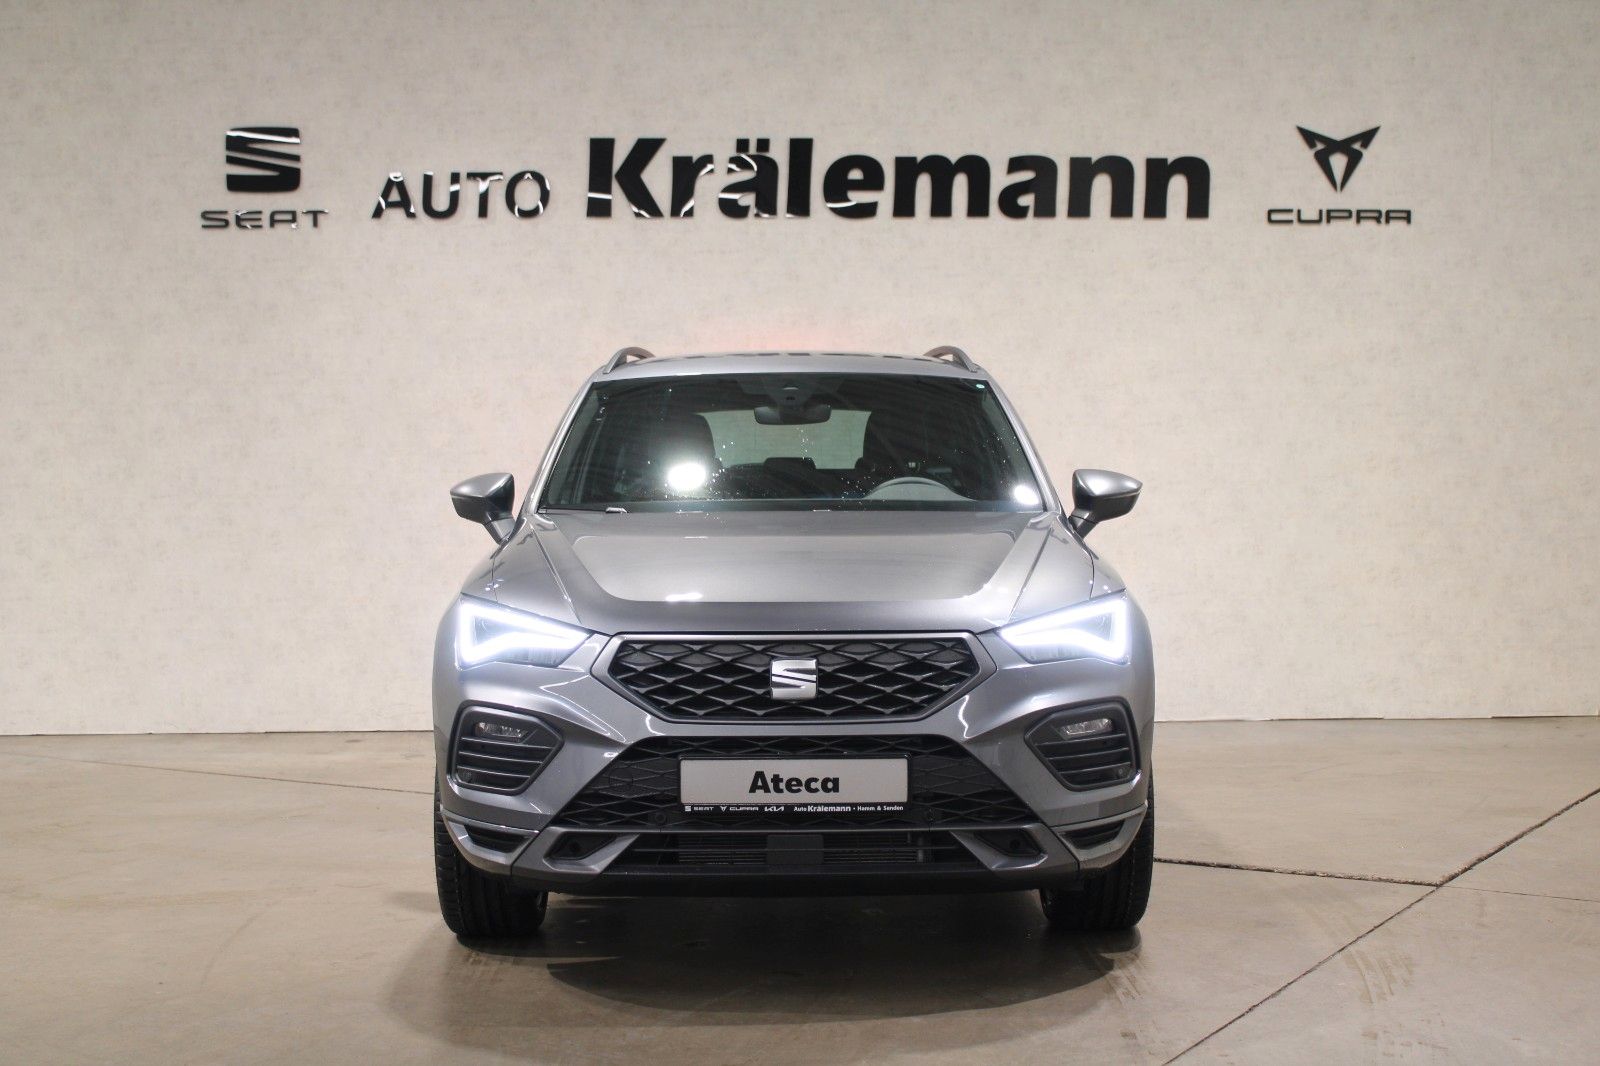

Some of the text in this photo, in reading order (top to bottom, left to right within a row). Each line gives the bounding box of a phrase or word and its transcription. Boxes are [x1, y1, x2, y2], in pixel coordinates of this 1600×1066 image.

[371, 137, 1211, 220] AUTO Krälemann
[200, 209, 328, 229] SEAT
[1267, 208, 1412, 226] CUPRA
[749, 771, 840, 794] Ateca
